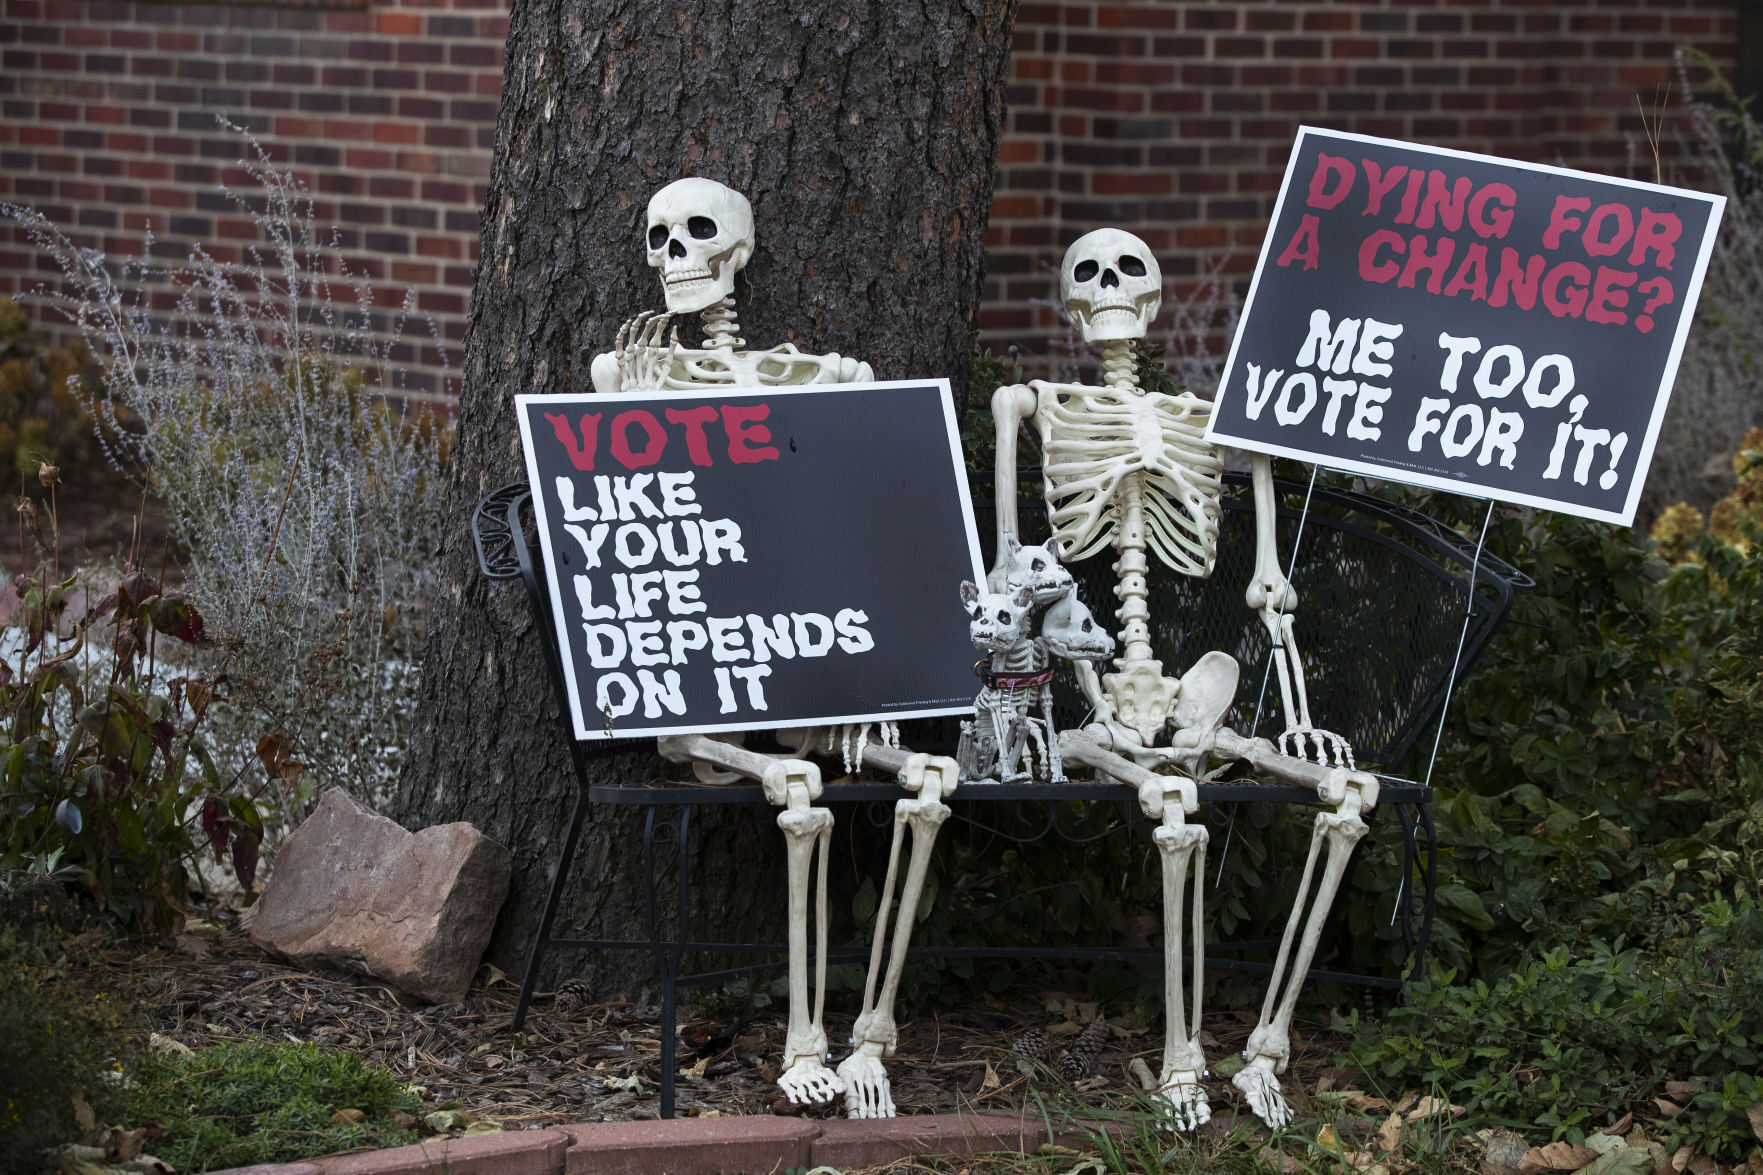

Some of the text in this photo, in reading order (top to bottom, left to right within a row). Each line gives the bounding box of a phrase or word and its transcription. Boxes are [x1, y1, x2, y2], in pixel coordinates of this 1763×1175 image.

[1307, 153, 1682, 270] DYING FOR
[1278, 214, 1673, 333] A CHANGE?
[1296, 309, 1589, 424] ME TOO,
[544, 403, 779, 471] VOTE
[1246, 362, 1628, 490] VOTE FOR IT!
[556, 471, 702, 521] LIKE
[564, 518, 747, 569] YOUR
[574, 569, 707, 620] LIFE
[583, 608, 874, 668] DEPENDS
[596, 664, 772, 719] ON IT
